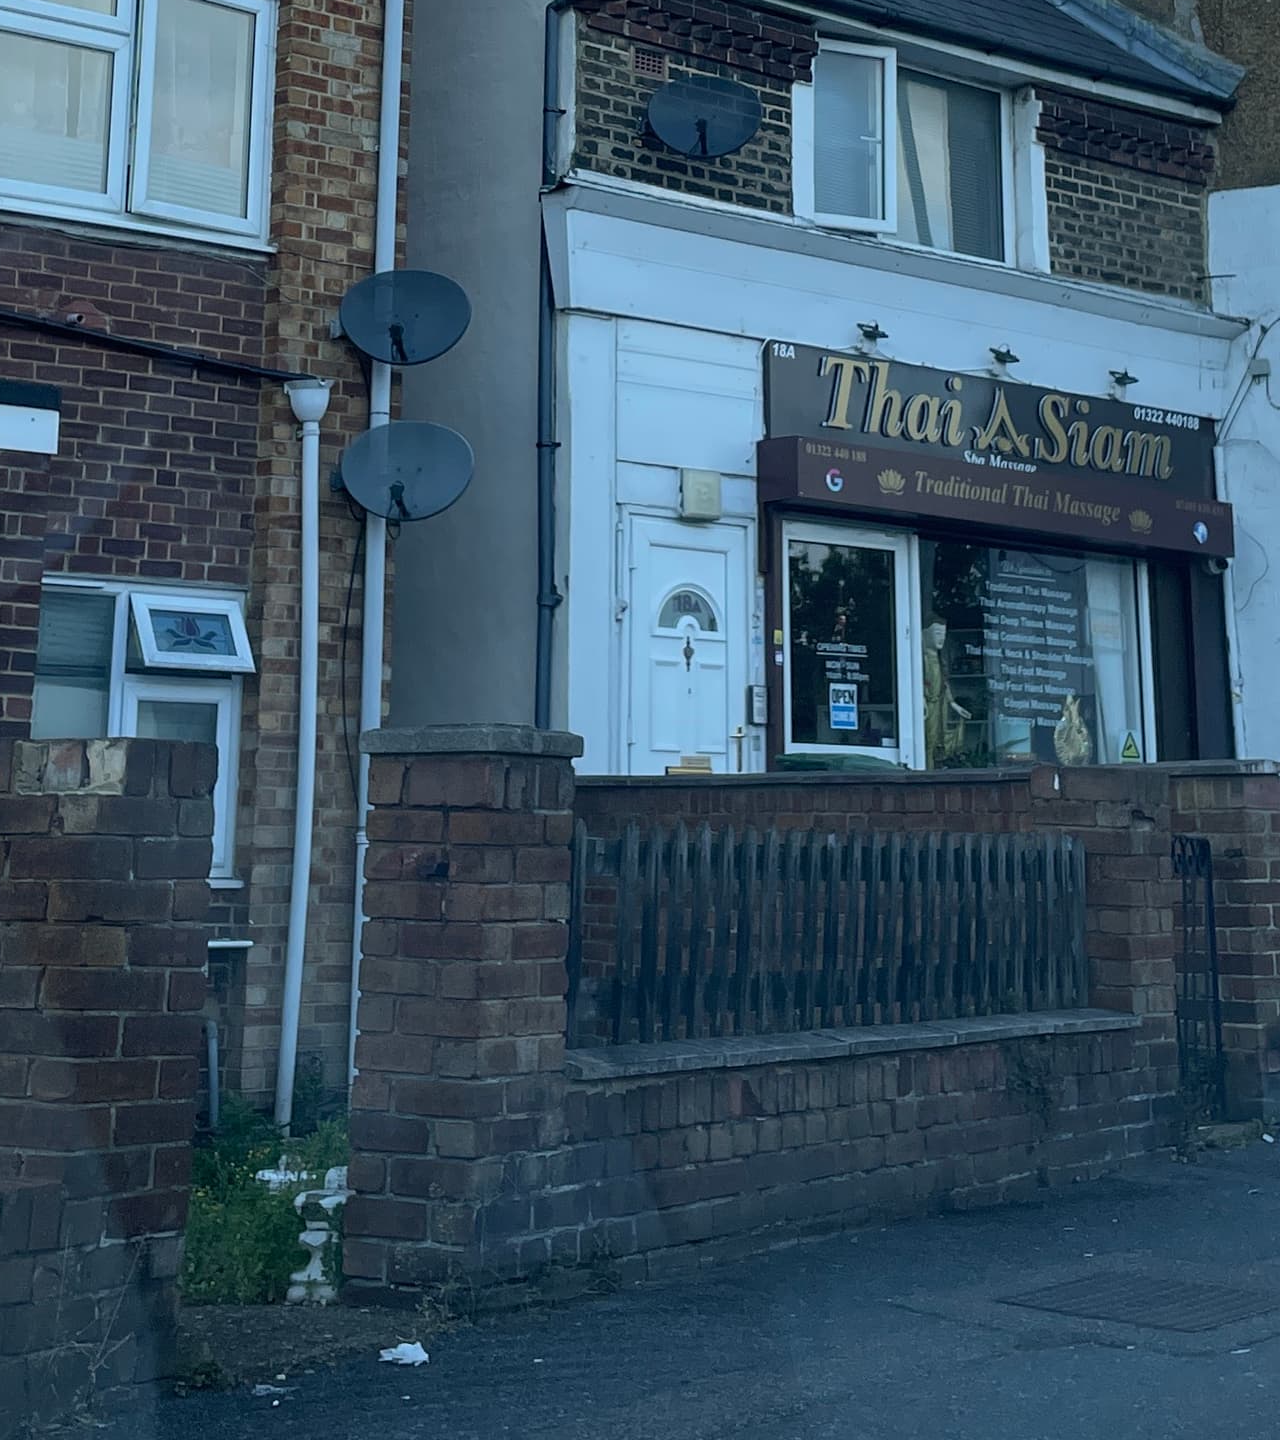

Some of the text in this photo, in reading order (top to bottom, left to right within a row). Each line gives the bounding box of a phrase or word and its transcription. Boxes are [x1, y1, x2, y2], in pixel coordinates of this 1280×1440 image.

[773, 343, 796, 359] 18A
[819, 356, 1173, 480] Thai Siam
[1133, 406, 1199, 431] 01322 440188
[805, 441, 832, 457] 01322
[915, 470, 1120, 526] Traditional Thai Massage
[831, 688, 855, 704] OPEN
